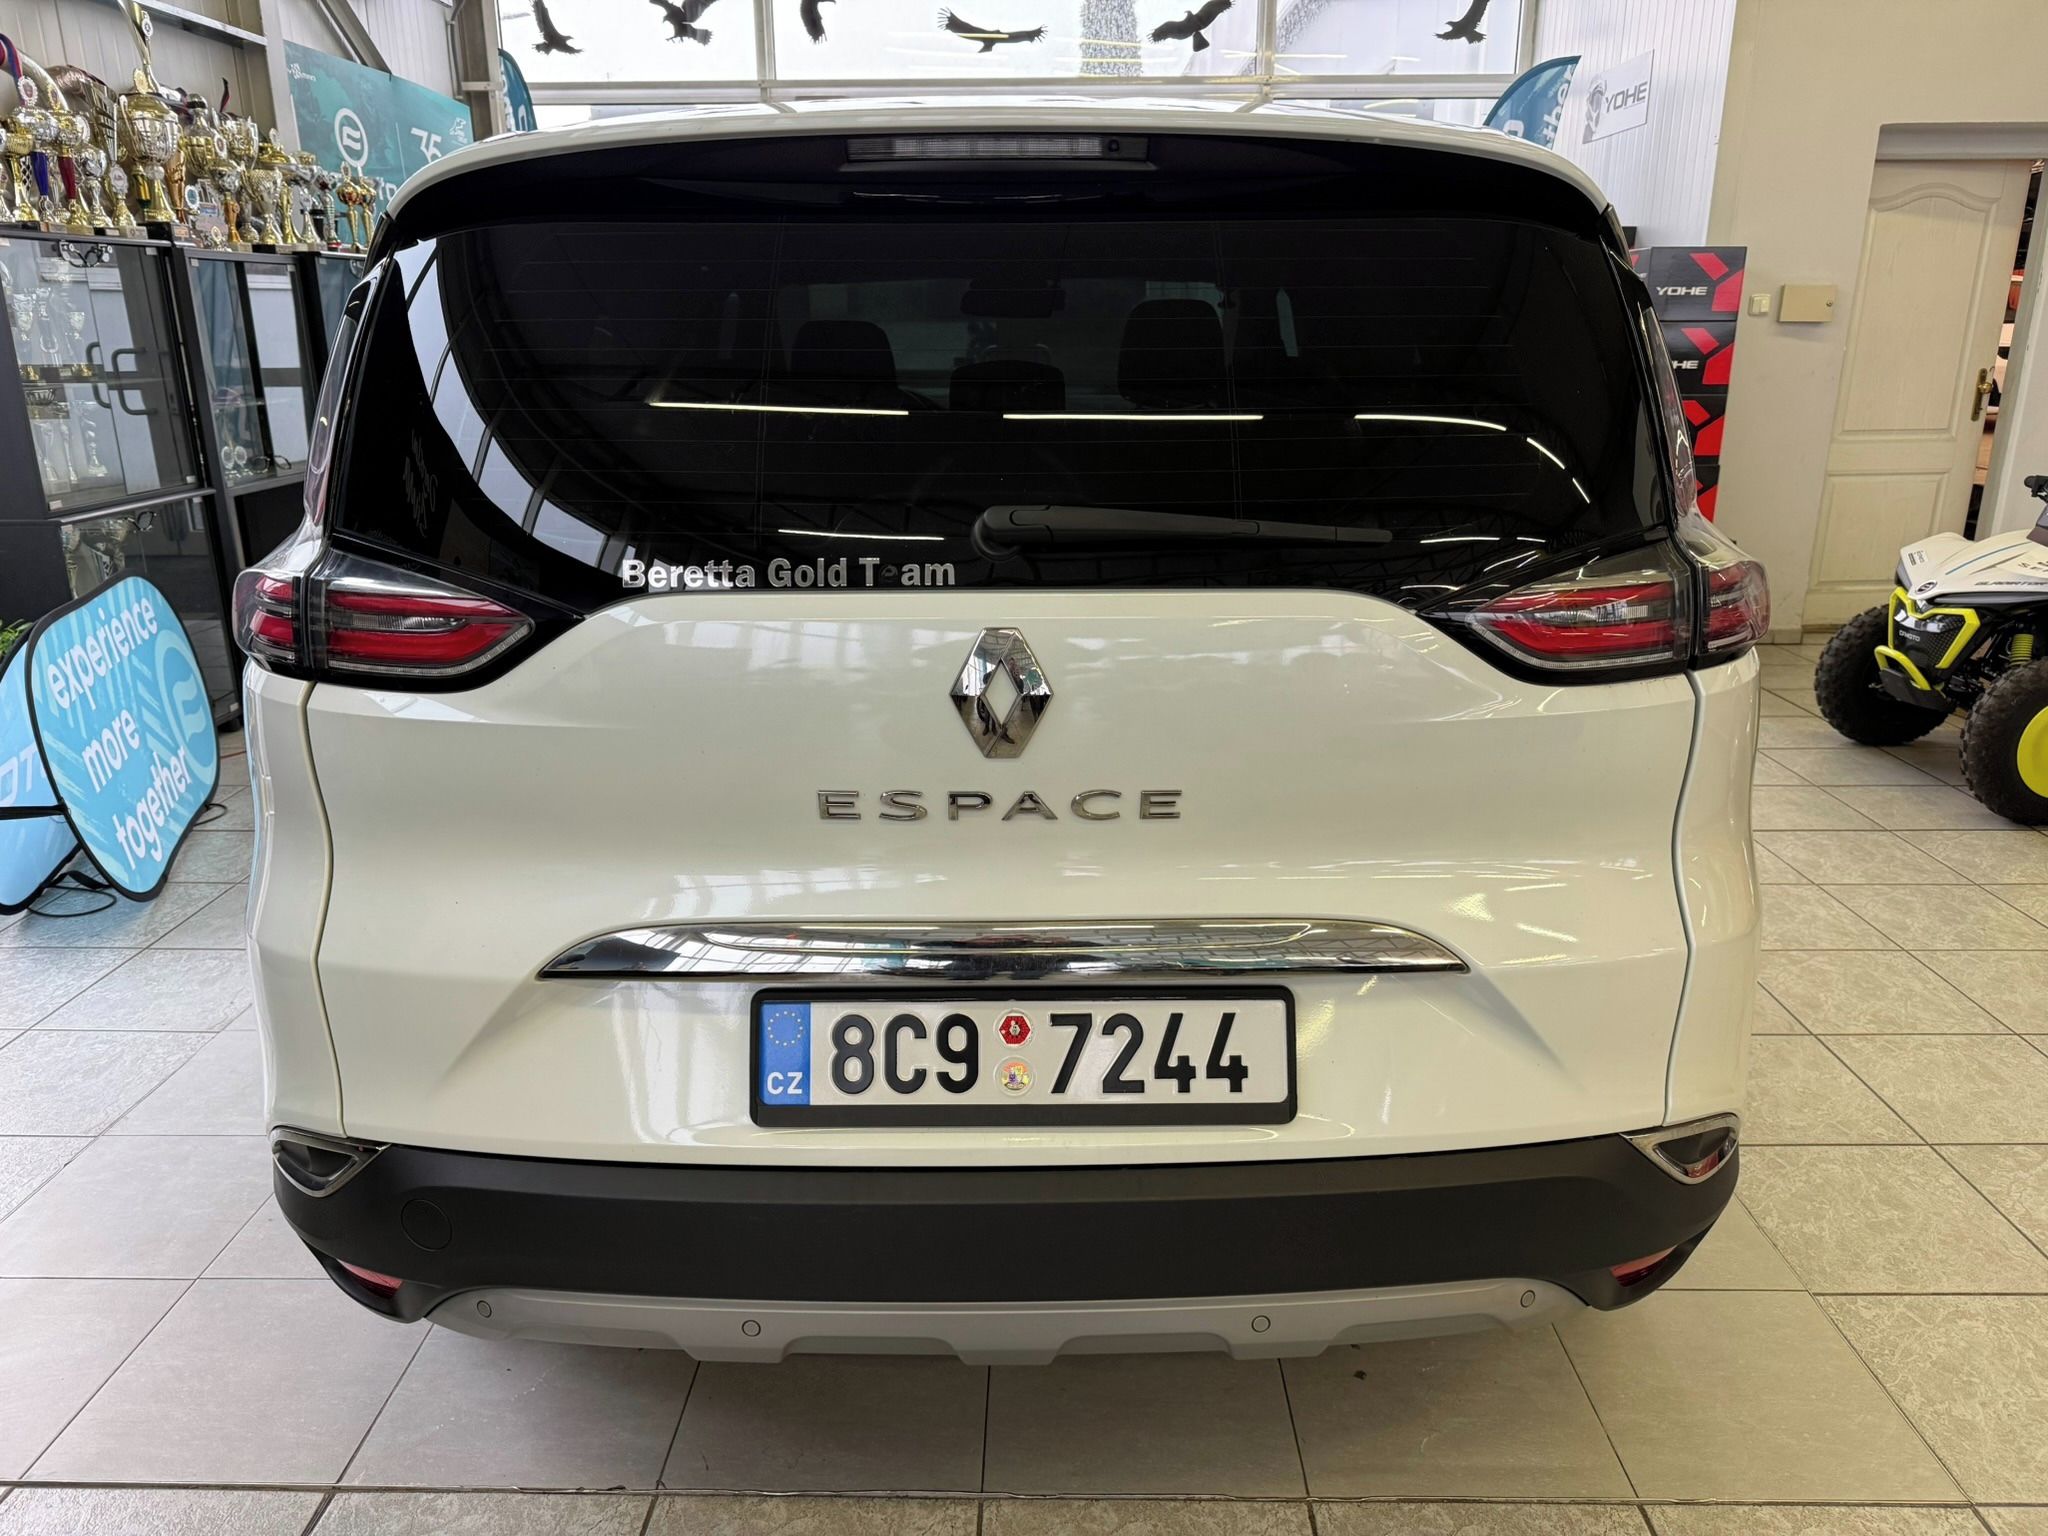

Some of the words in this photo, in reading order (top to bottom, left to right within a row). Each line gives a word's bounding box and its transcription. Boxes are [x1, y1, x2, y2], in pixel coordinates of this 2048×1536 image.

[1605, 80, 1648, 114] YOHE
[1655, 286, 1708, 296] YOHE
[1671, 360, 1699, 369] HE
[622, 558, 756, 588] Beretta
[767, 557, 848, 588] Gold
[47, 597, 158, 710] experience
[82, 709, 140, 793] more
[112, 745, 192, 870] together
[816, 789, 1182, 821] ESPACE
[831, 1013, 979, 1095] 8C9
[1049, 1011, 1249, 1094] 7244
[766, 1071, 804, 1096] CZ
